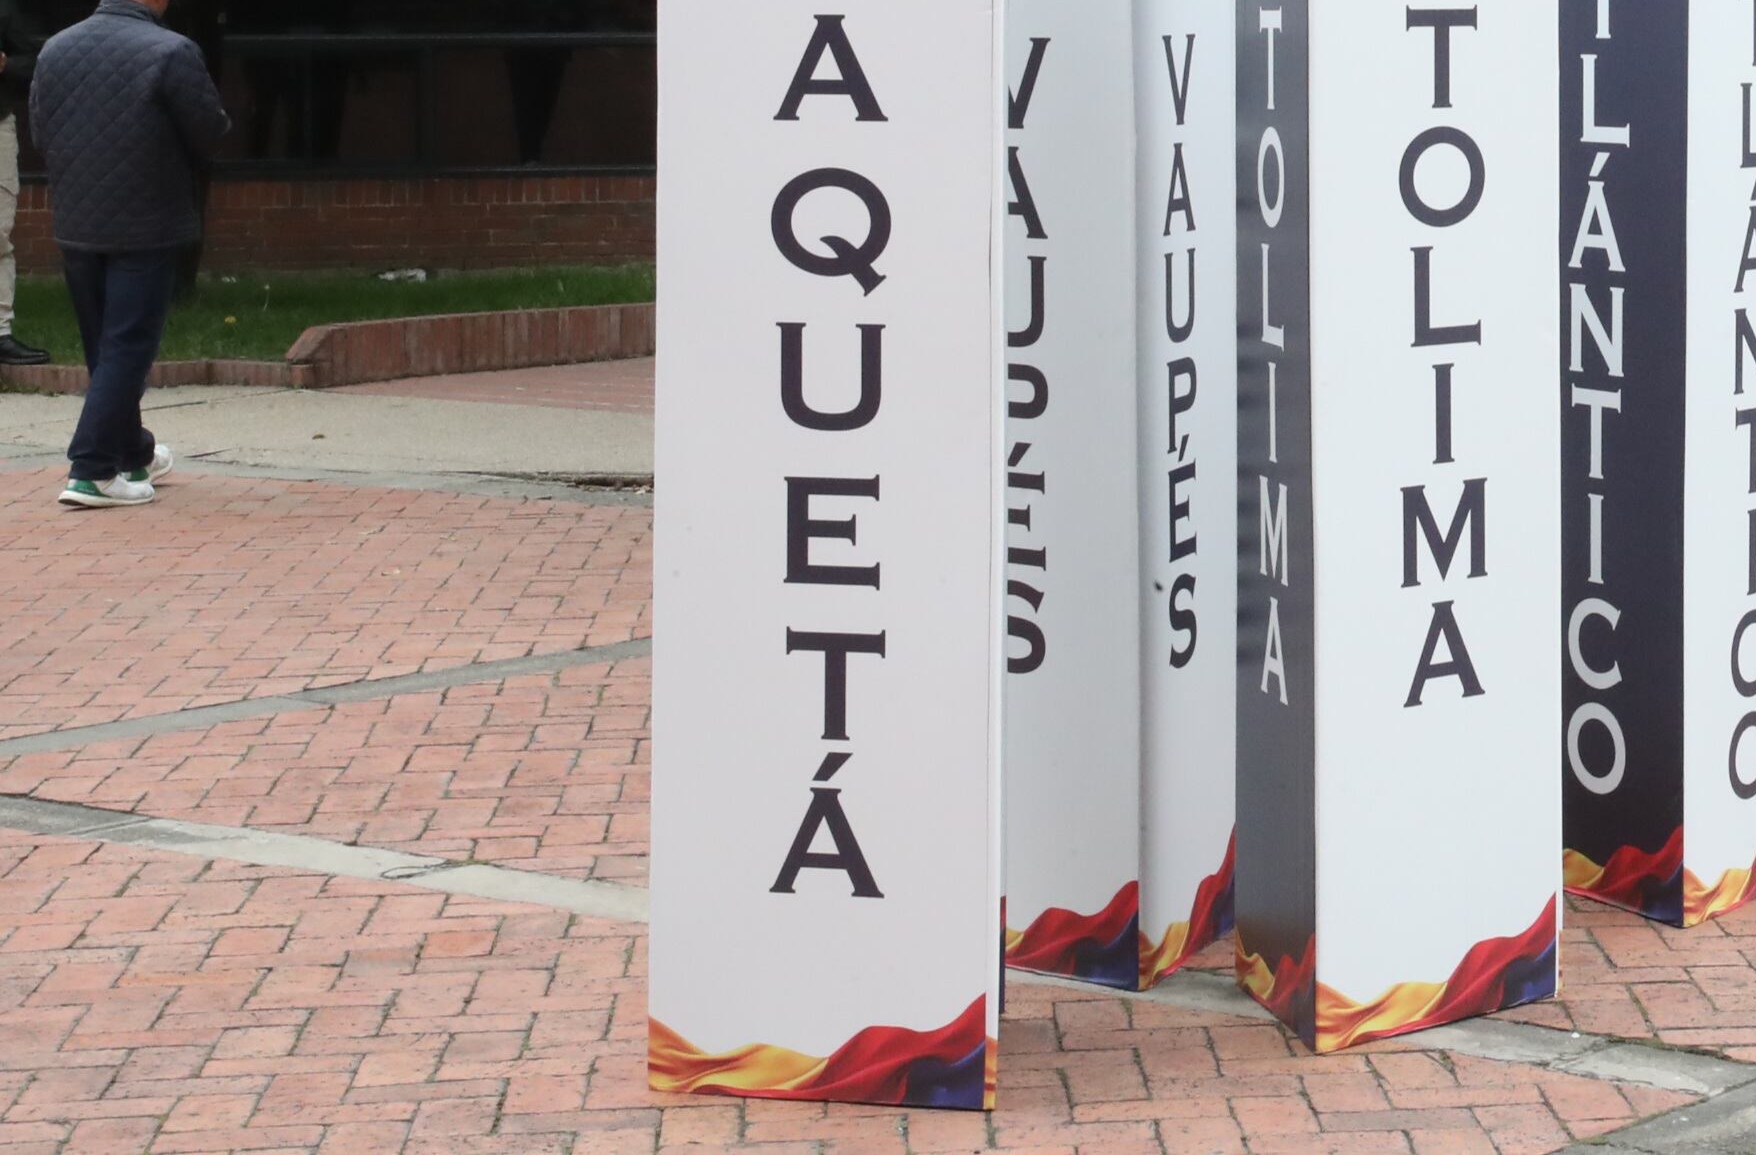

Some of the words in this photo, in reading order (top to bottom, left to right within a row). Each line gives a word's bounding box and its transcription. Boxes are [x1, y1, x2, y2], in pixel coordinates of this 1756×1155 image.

[1161, 34, 1198, 669] VAUPÉS
[1257, 5, 1289, 706] TOLIMA
[1399, 4, 1488, 708] TOLIMA
